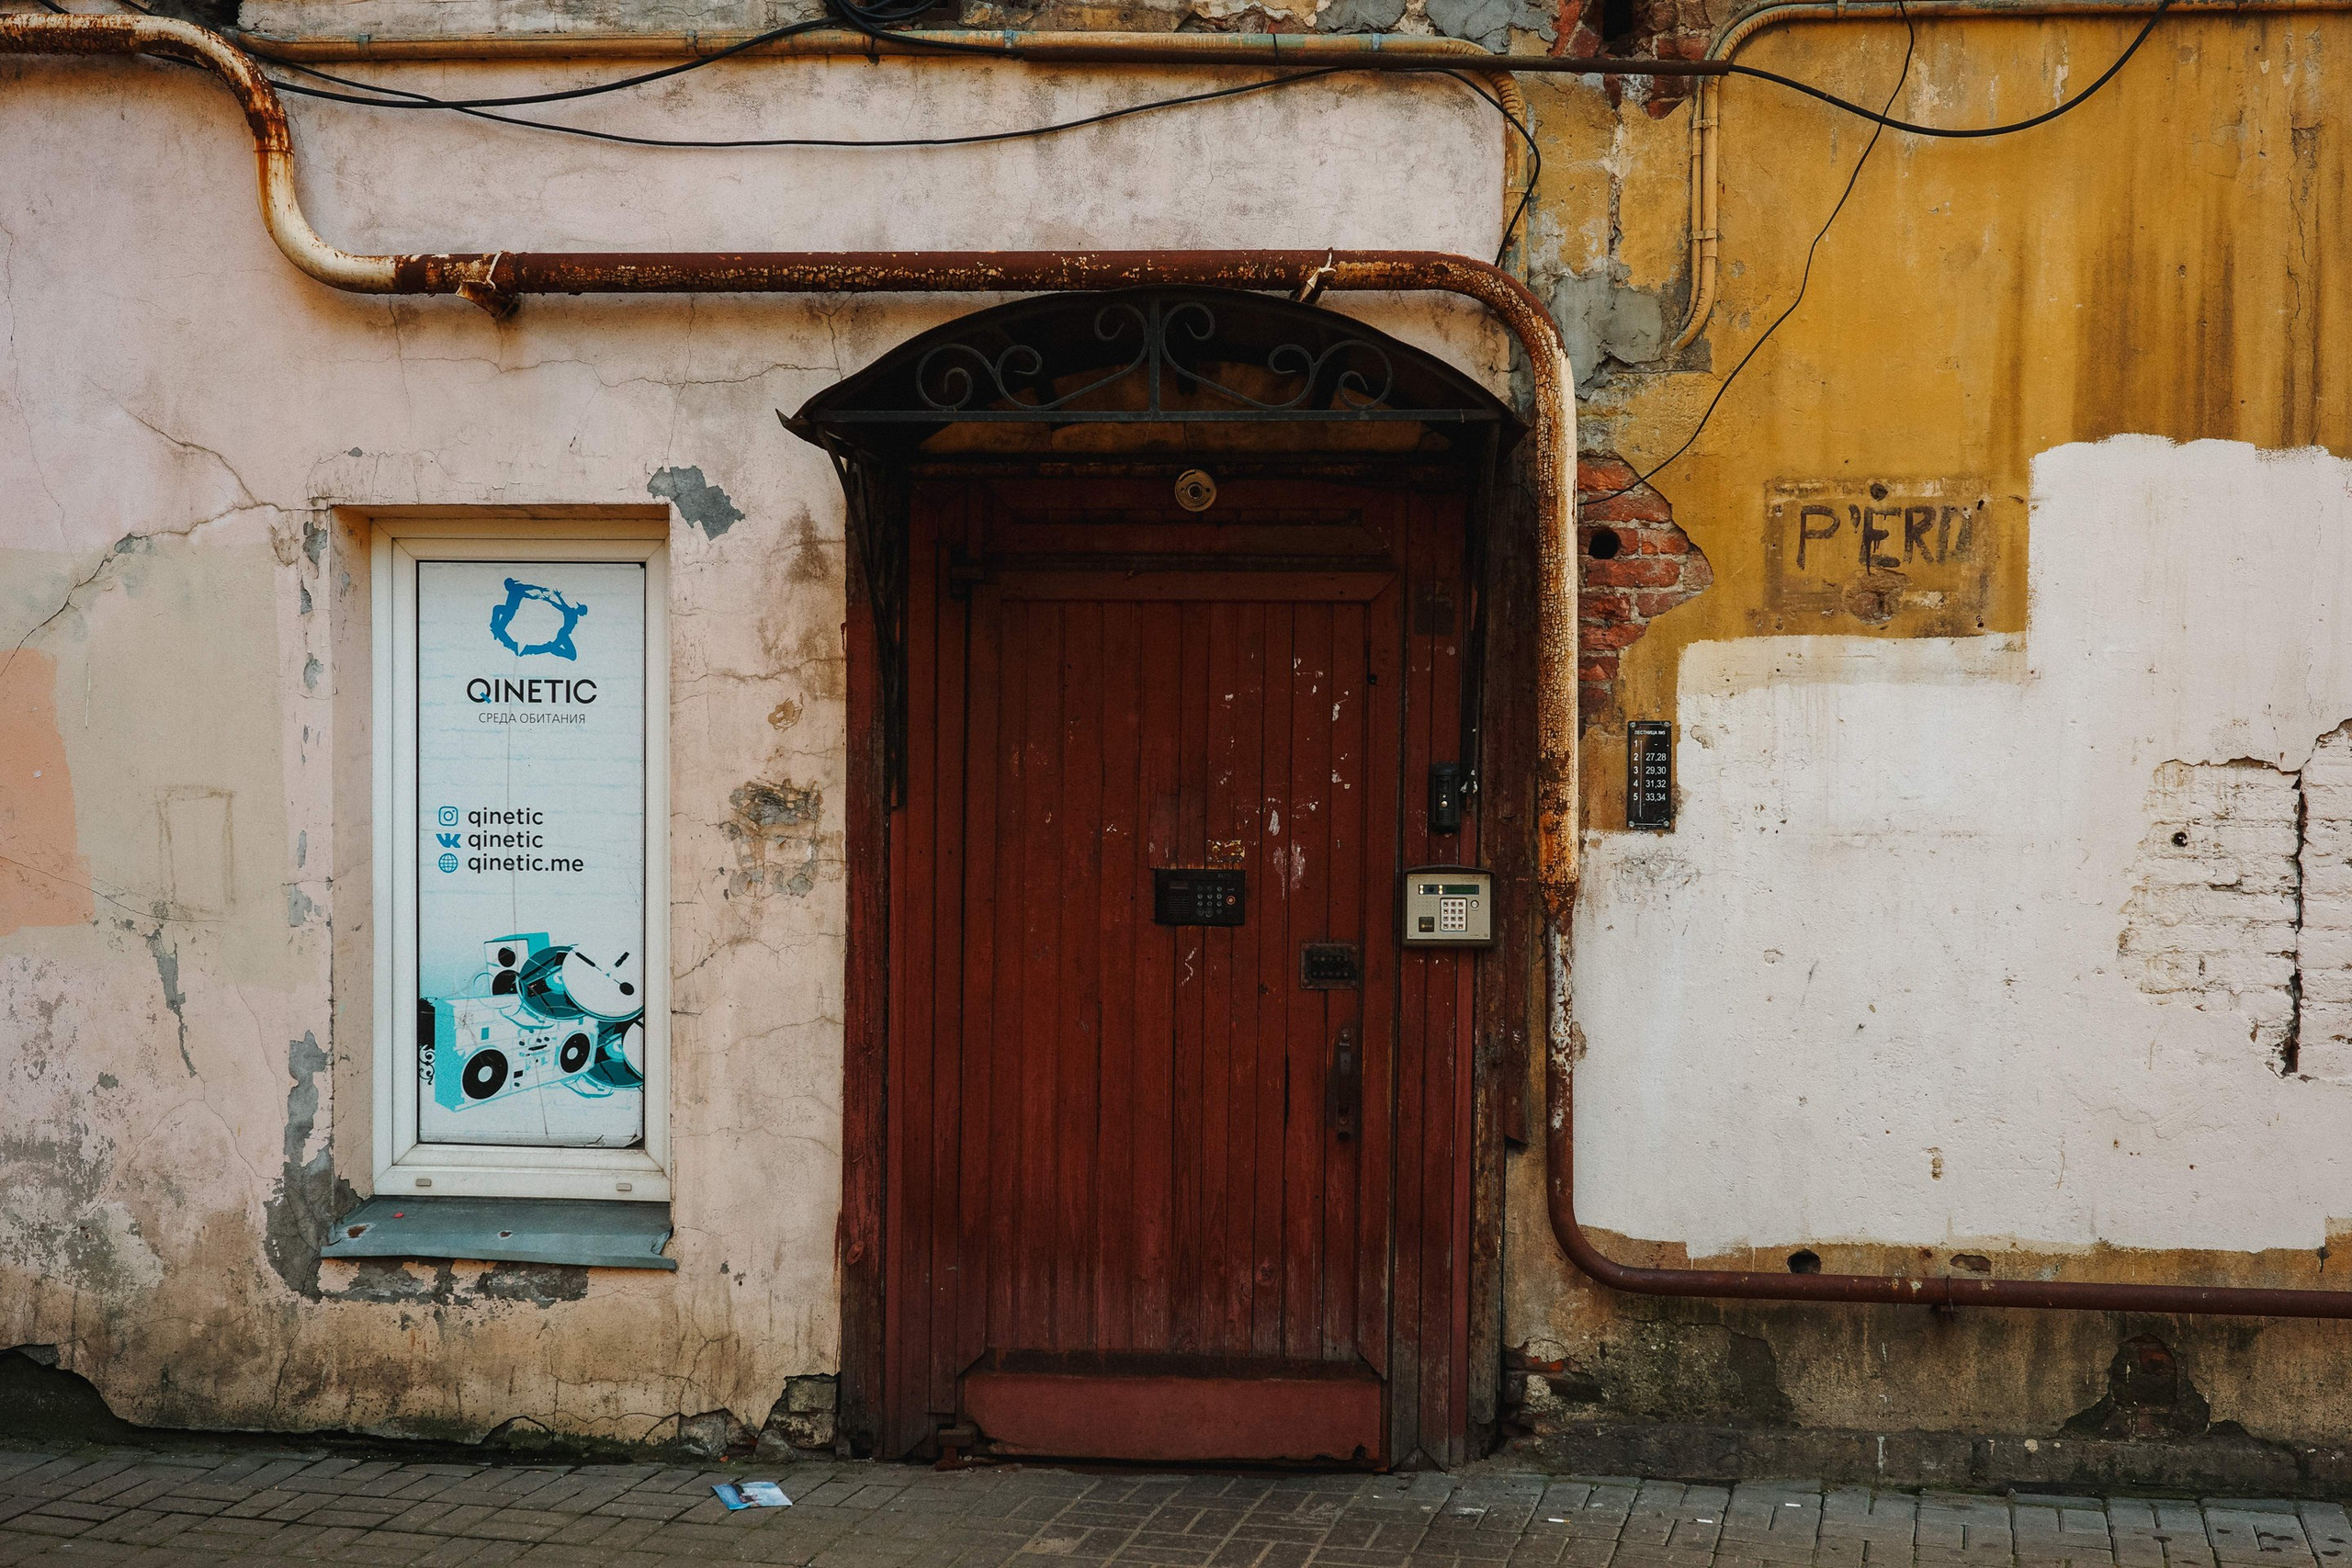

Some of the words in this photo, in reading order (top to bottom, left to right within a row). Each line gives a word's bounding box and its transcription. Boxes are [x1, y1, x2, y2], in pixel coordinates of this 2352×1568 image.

[466, 678, 598, 704] QINETIC
[478, 712, 517, 725] СРЕДА
[519, 713, 586, 725] ОБИТАНИЯ
[1634, 739, 1638, 748] 1
[1634, 753, 1638, 761] 2
[1645, 753, 1667, 761] 27,28
[1634, 766, 1639, 774] 3
[1645, 766, 1667, 775] 29,30
[1633, 779, 1639, 787] 4
[1645, 779, 1667, 789] 31,32
[1633, 793, 1638, 801] 5
[1645, 793, 1667, 802] 33,34
[467, 807, 544, 827] qinetic
[467, 830, 544, 850] qinetic
[467, 853, 584, 874] qinetic.me
